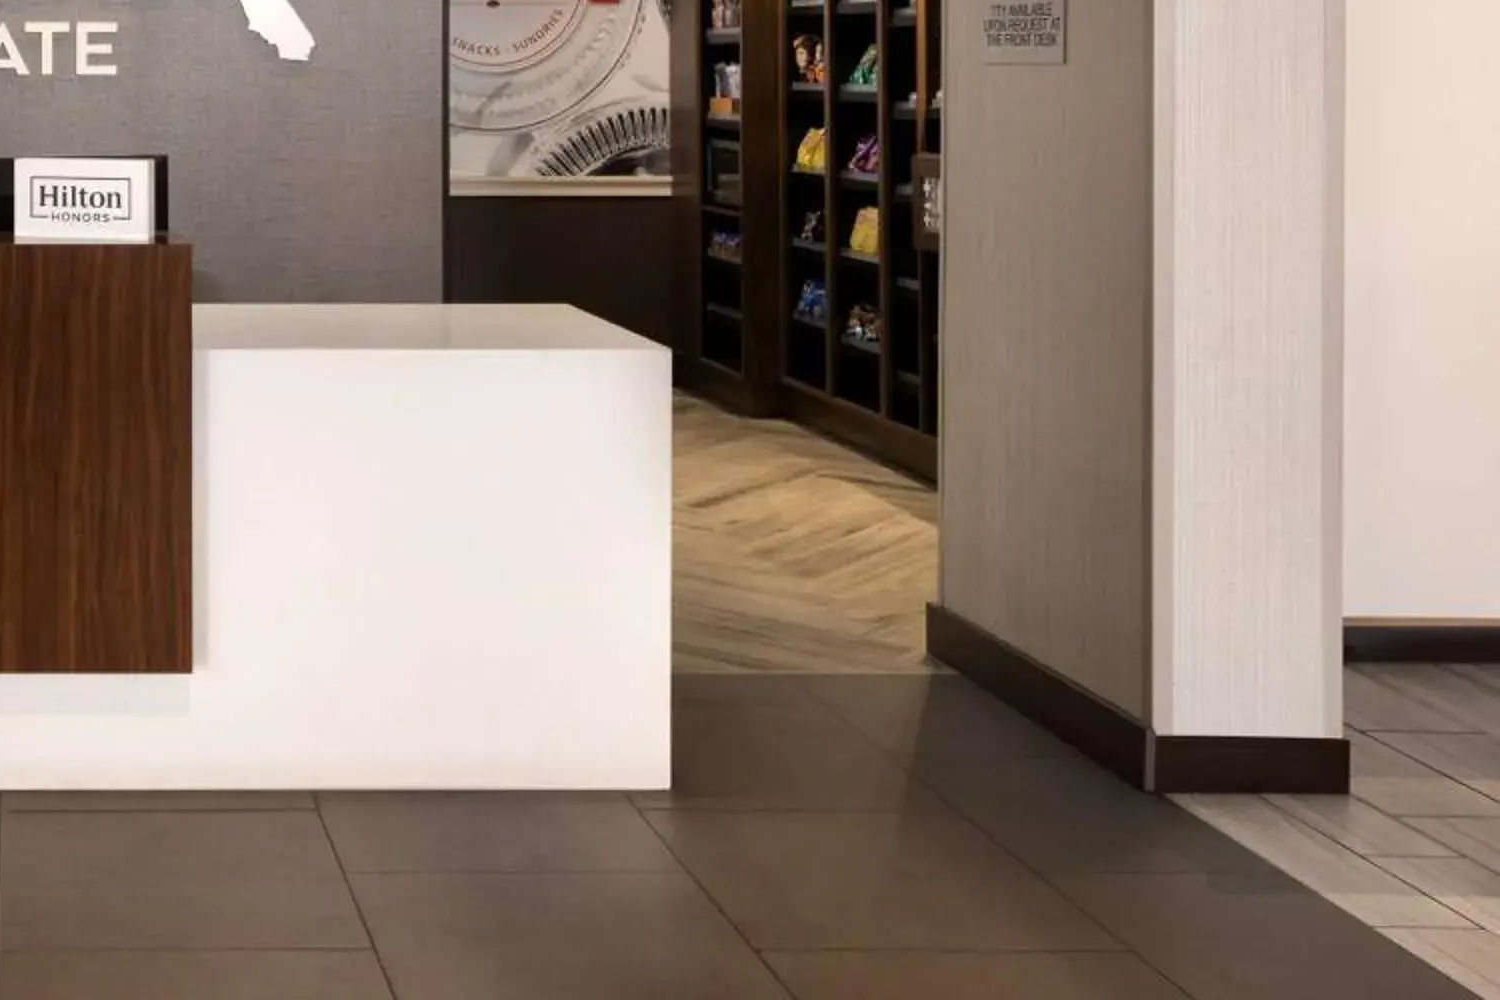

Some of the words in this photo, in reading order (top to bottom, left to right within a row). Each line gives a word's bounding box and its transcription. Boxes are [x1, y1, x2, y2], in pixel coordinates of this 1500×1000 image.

[512, 9, 564, 52] SUNDRIES
[39, 185, 122, 209] Hilton
[51, 211, 111, 223] HONORS
